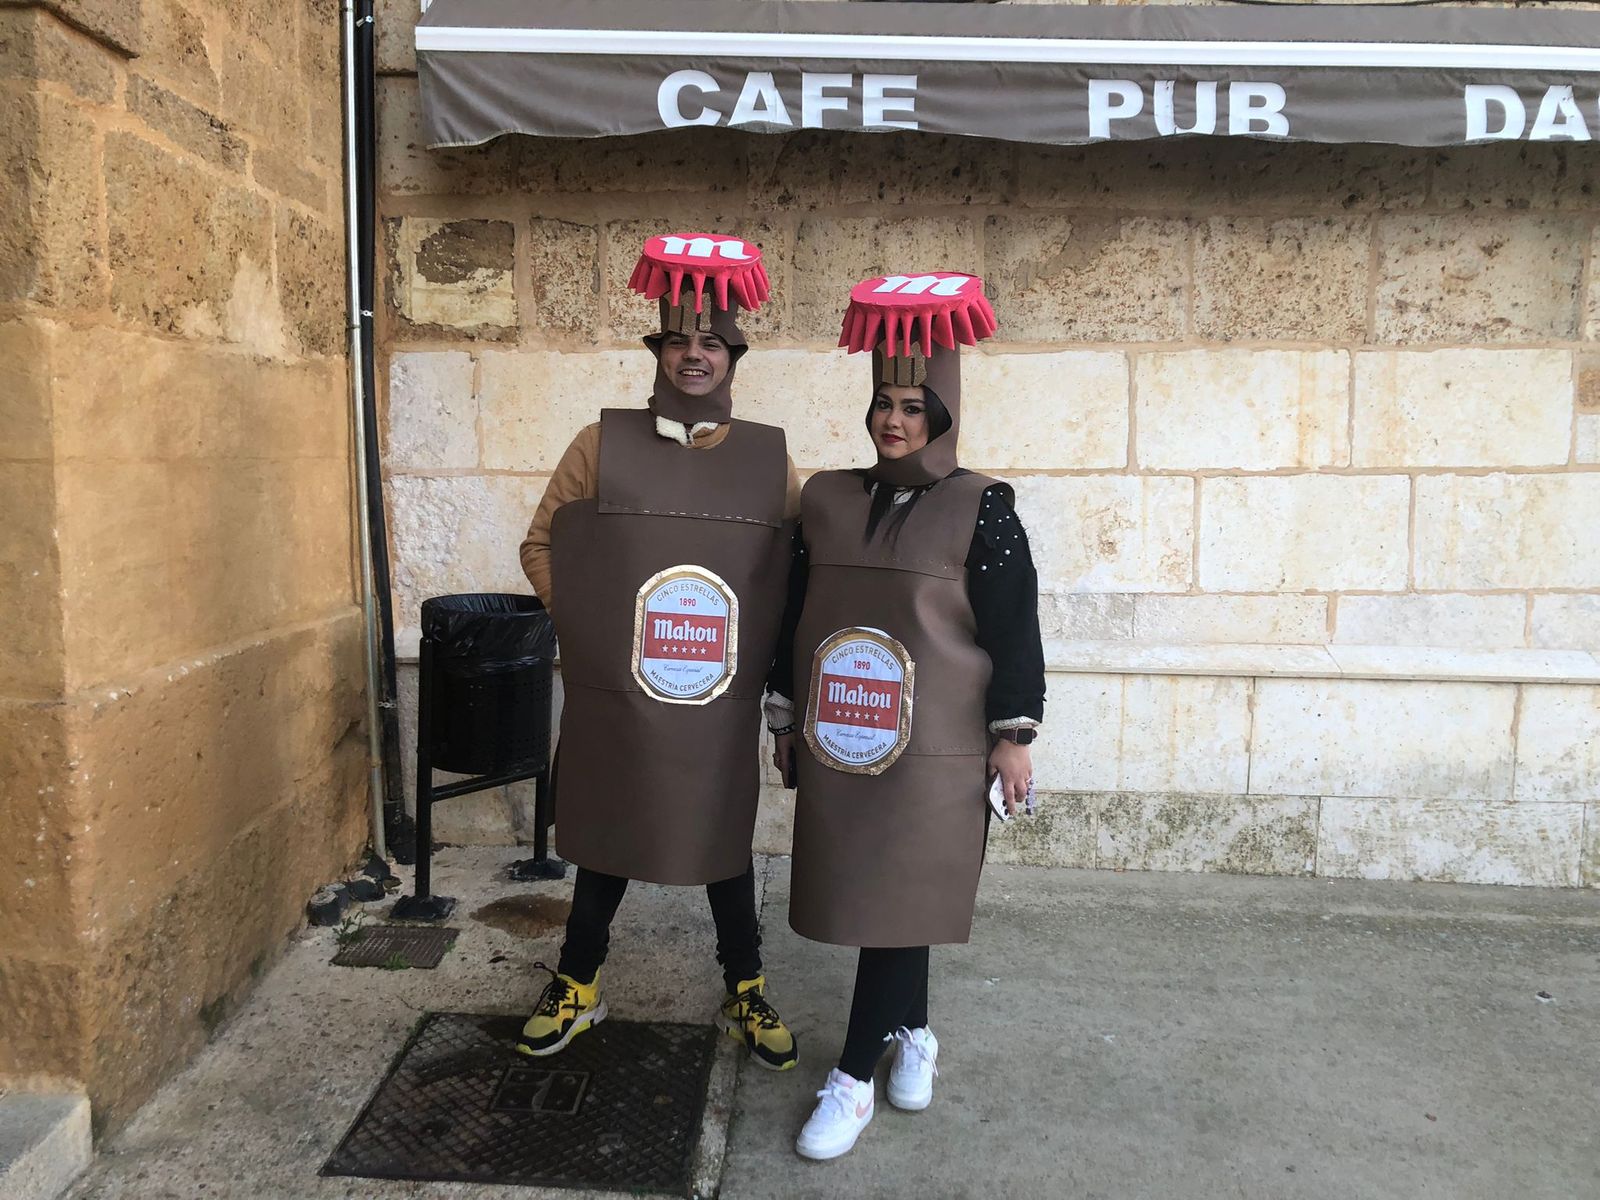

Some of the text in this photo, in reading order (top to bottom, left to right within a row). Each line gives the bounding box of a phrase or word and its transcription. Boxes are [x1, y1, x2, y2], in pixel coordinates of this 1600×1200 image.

[657, 69, 1600, 141] CAFE PUB DA
[656, 583, 720, 606] CINCO ESTRELLAS
[679, 597, 697, 607] 1890
[653, 618, 717, 643] Mahou
[831, 645, 895, 670] CINCO ESTRELLAS
[854, 660, 871, 671] 1890
[679, 673, 714, 692] CERVECERA
[828, 681, 892, 709] Mahou
[851, 742, 887, 760] CERVECERA
